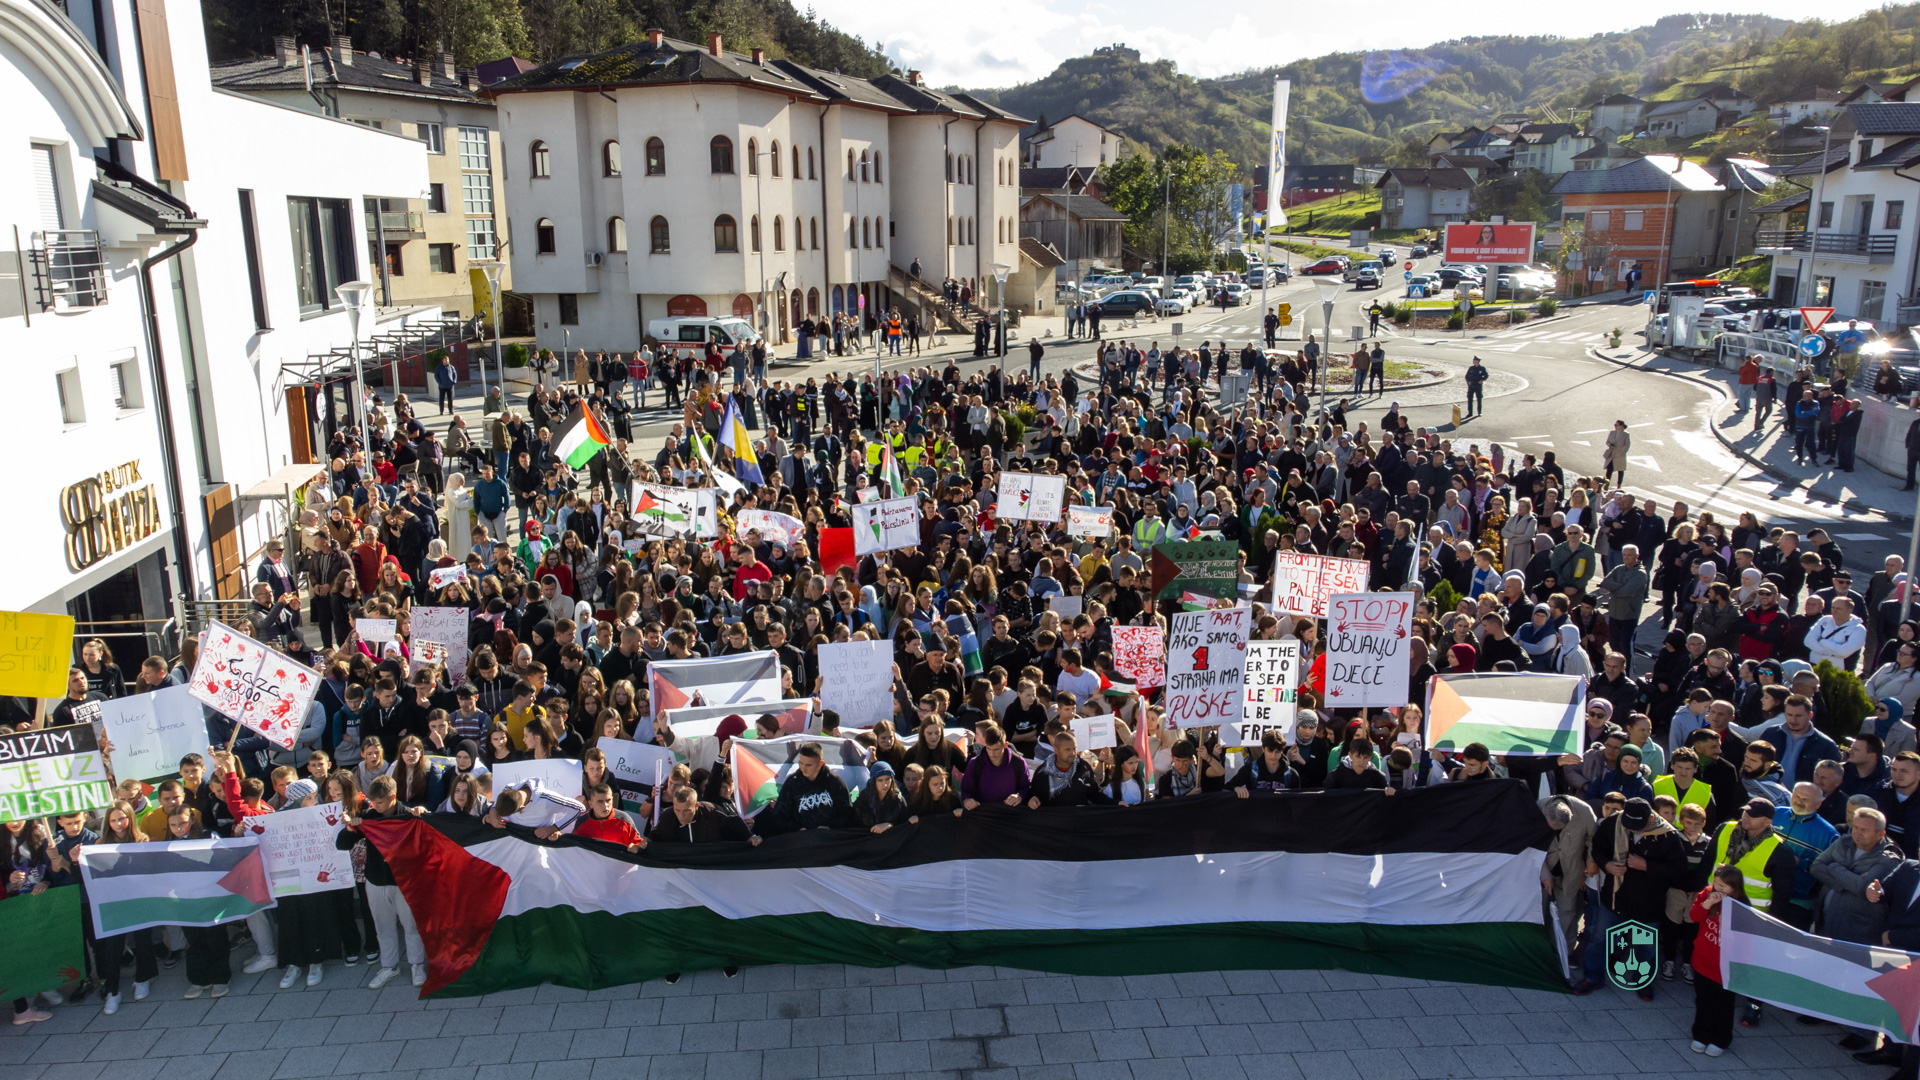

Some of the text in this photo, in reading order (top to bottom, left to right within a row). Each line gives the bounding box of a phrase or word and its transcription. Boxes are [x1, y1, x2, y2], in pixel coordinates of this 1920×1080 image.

[99, 459, 142, 494] BUTIK
[1279, 553, 1370, 575] FROM THE RIVER
[1281, 567, 1359, 591] TO THE SEA
[1278, 596, 1328, 617] WILL BE
[1334, 599, 1409, 624] STOP!
[1173, 615, 1205, 634] NIJE
[16, 636, 43, 651] UZ
[1171, 632, 1238, 650] AKO SAMO
[1191, 646, 1209, 670] 1
[1267, 647, 1296, 658] THE
[1266, 659, 1289, 672] TO
[1332, 662, 1385, 685] DJECE
[1171, 667, 1239, 691] STRANA IMA
[1256, 672, 1285, 685] SEA
[229, 679, 261, 702] 3000
[1169, 687, 1237, 722] PUŠKE
[1256, 706, 1271, 720] BE
[0, 730, 75, 760] BUŽIM
[1, 754, 98, 790] JE UZ
[615, 756, 641, 775] Peace
[621, 790, 639, 801] FOR
[269, 836, 335, 853] STAND UP FOR GAZA
[280, 834, 290, 842] BE
[292, 831, 318, 841] MUSLIM
[321, 829, 330, 838] TO
[287, 848, 303, 858] JUST
[305, 845, 322, 855] NEED
[324, 844, 335, 853] TO
[287, 852, 324, 866] BE HUMAN
